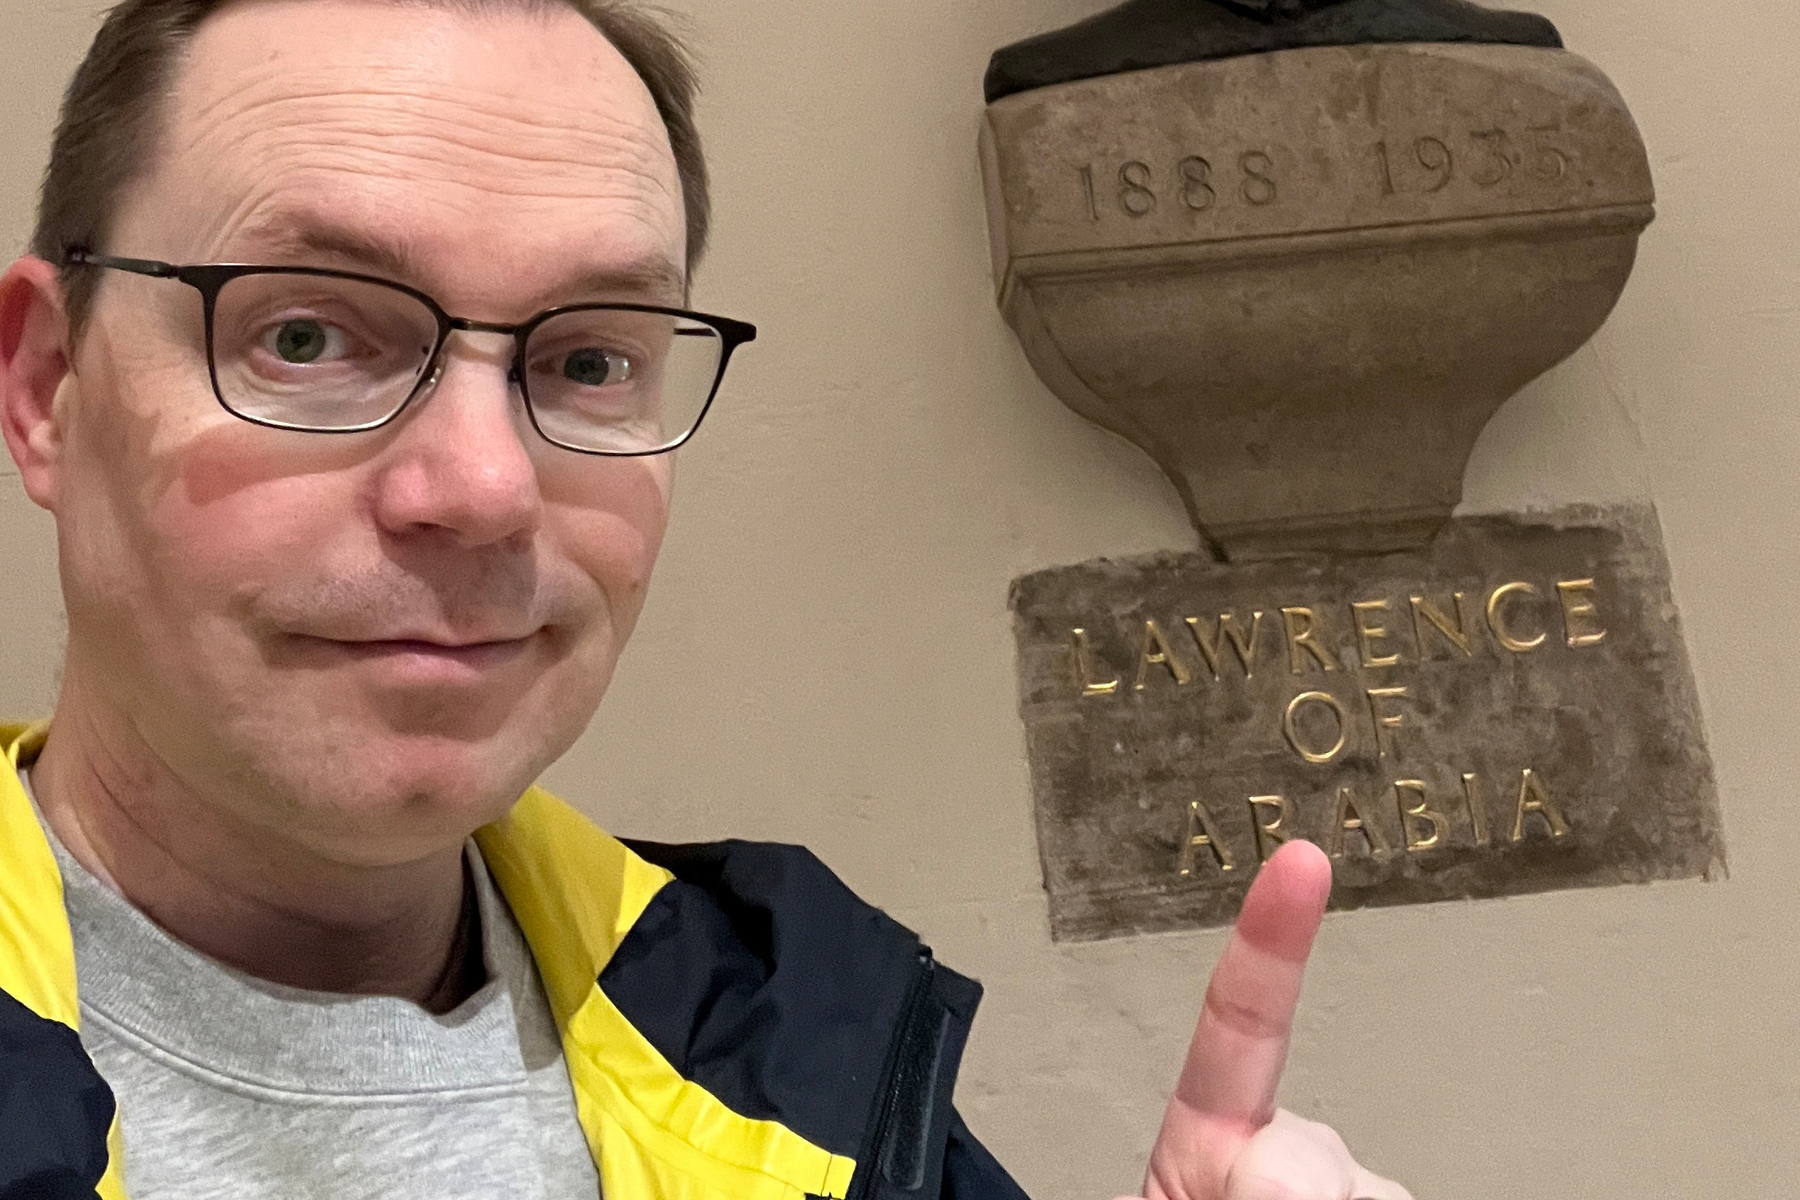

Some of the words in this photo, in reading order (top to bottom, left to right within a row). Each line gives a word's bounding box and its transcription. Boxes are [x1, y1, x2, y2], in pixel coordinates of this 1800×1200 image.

[1077, 149, 1278, 223] 1888
[1374, 125, 1571, 195] 1935
[1069, 577, 1607, 696] LAWRENCE
[1282, 685, 1409, 764] OF
[1179, 768, 1571, 876] ARABIA
